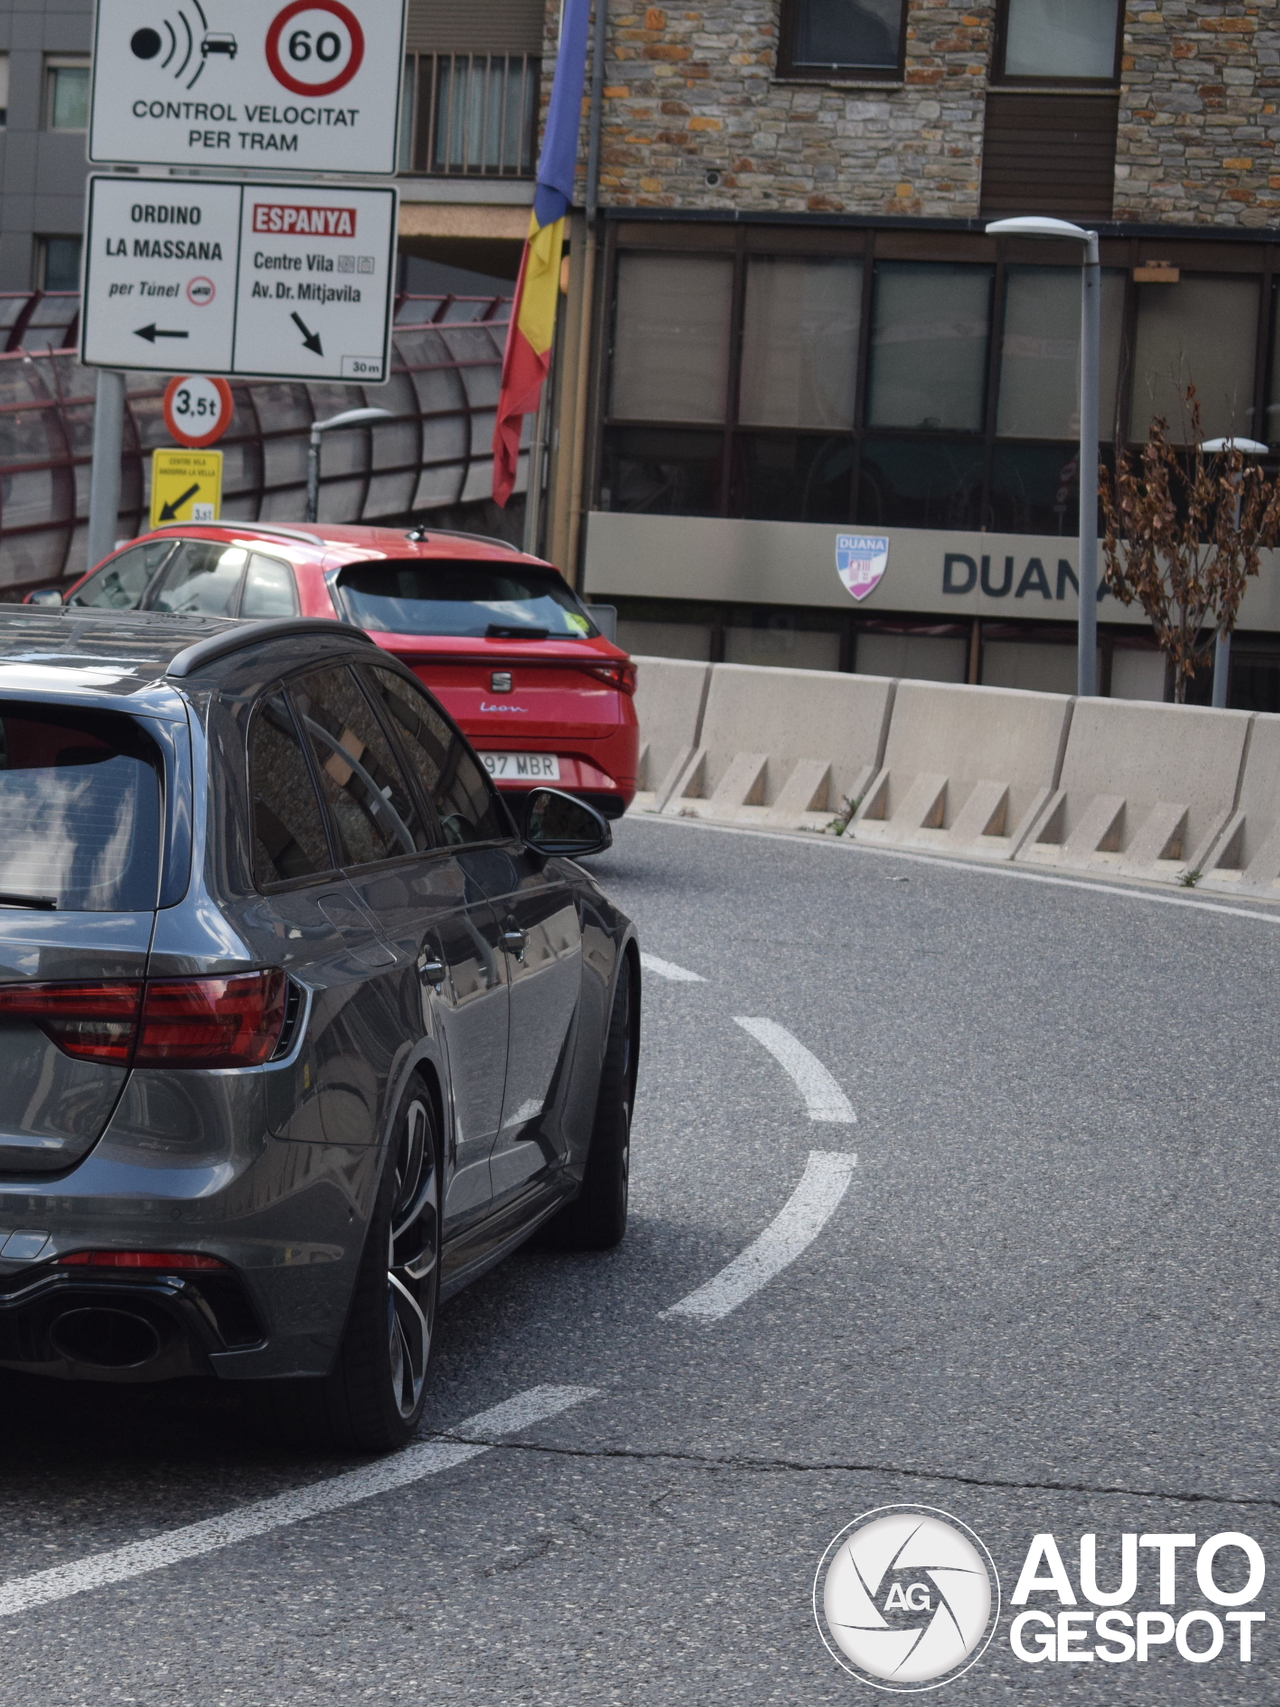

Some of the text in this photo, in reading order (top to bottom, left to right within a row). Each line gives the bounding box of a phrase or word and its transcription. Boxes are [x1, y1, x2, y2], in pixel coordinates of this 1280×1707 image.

[288, 30, 341, 62] 60
[132, 100, 360, 126] CONTROL VELOCITAT
[189, 130, 299, 151] PER TRAM
[131, 204, 201, 225] ORDINO
[255, 206, 352, 235] ESPANYA
[105, 238, 223, 261] LA MASSANA
[254, 252, 334, 272] Centre Vila
[109, 281, 180, 298] per Túnel
[252, 281, 361, 305] Av. Dr. Mitjavila
[353, 362, 380, 374] 30 m
[840, 538, 885, 550] DUANA
[479, 701, 529, 713] Leon
[483, 755, 554, 776] 97 MBR
